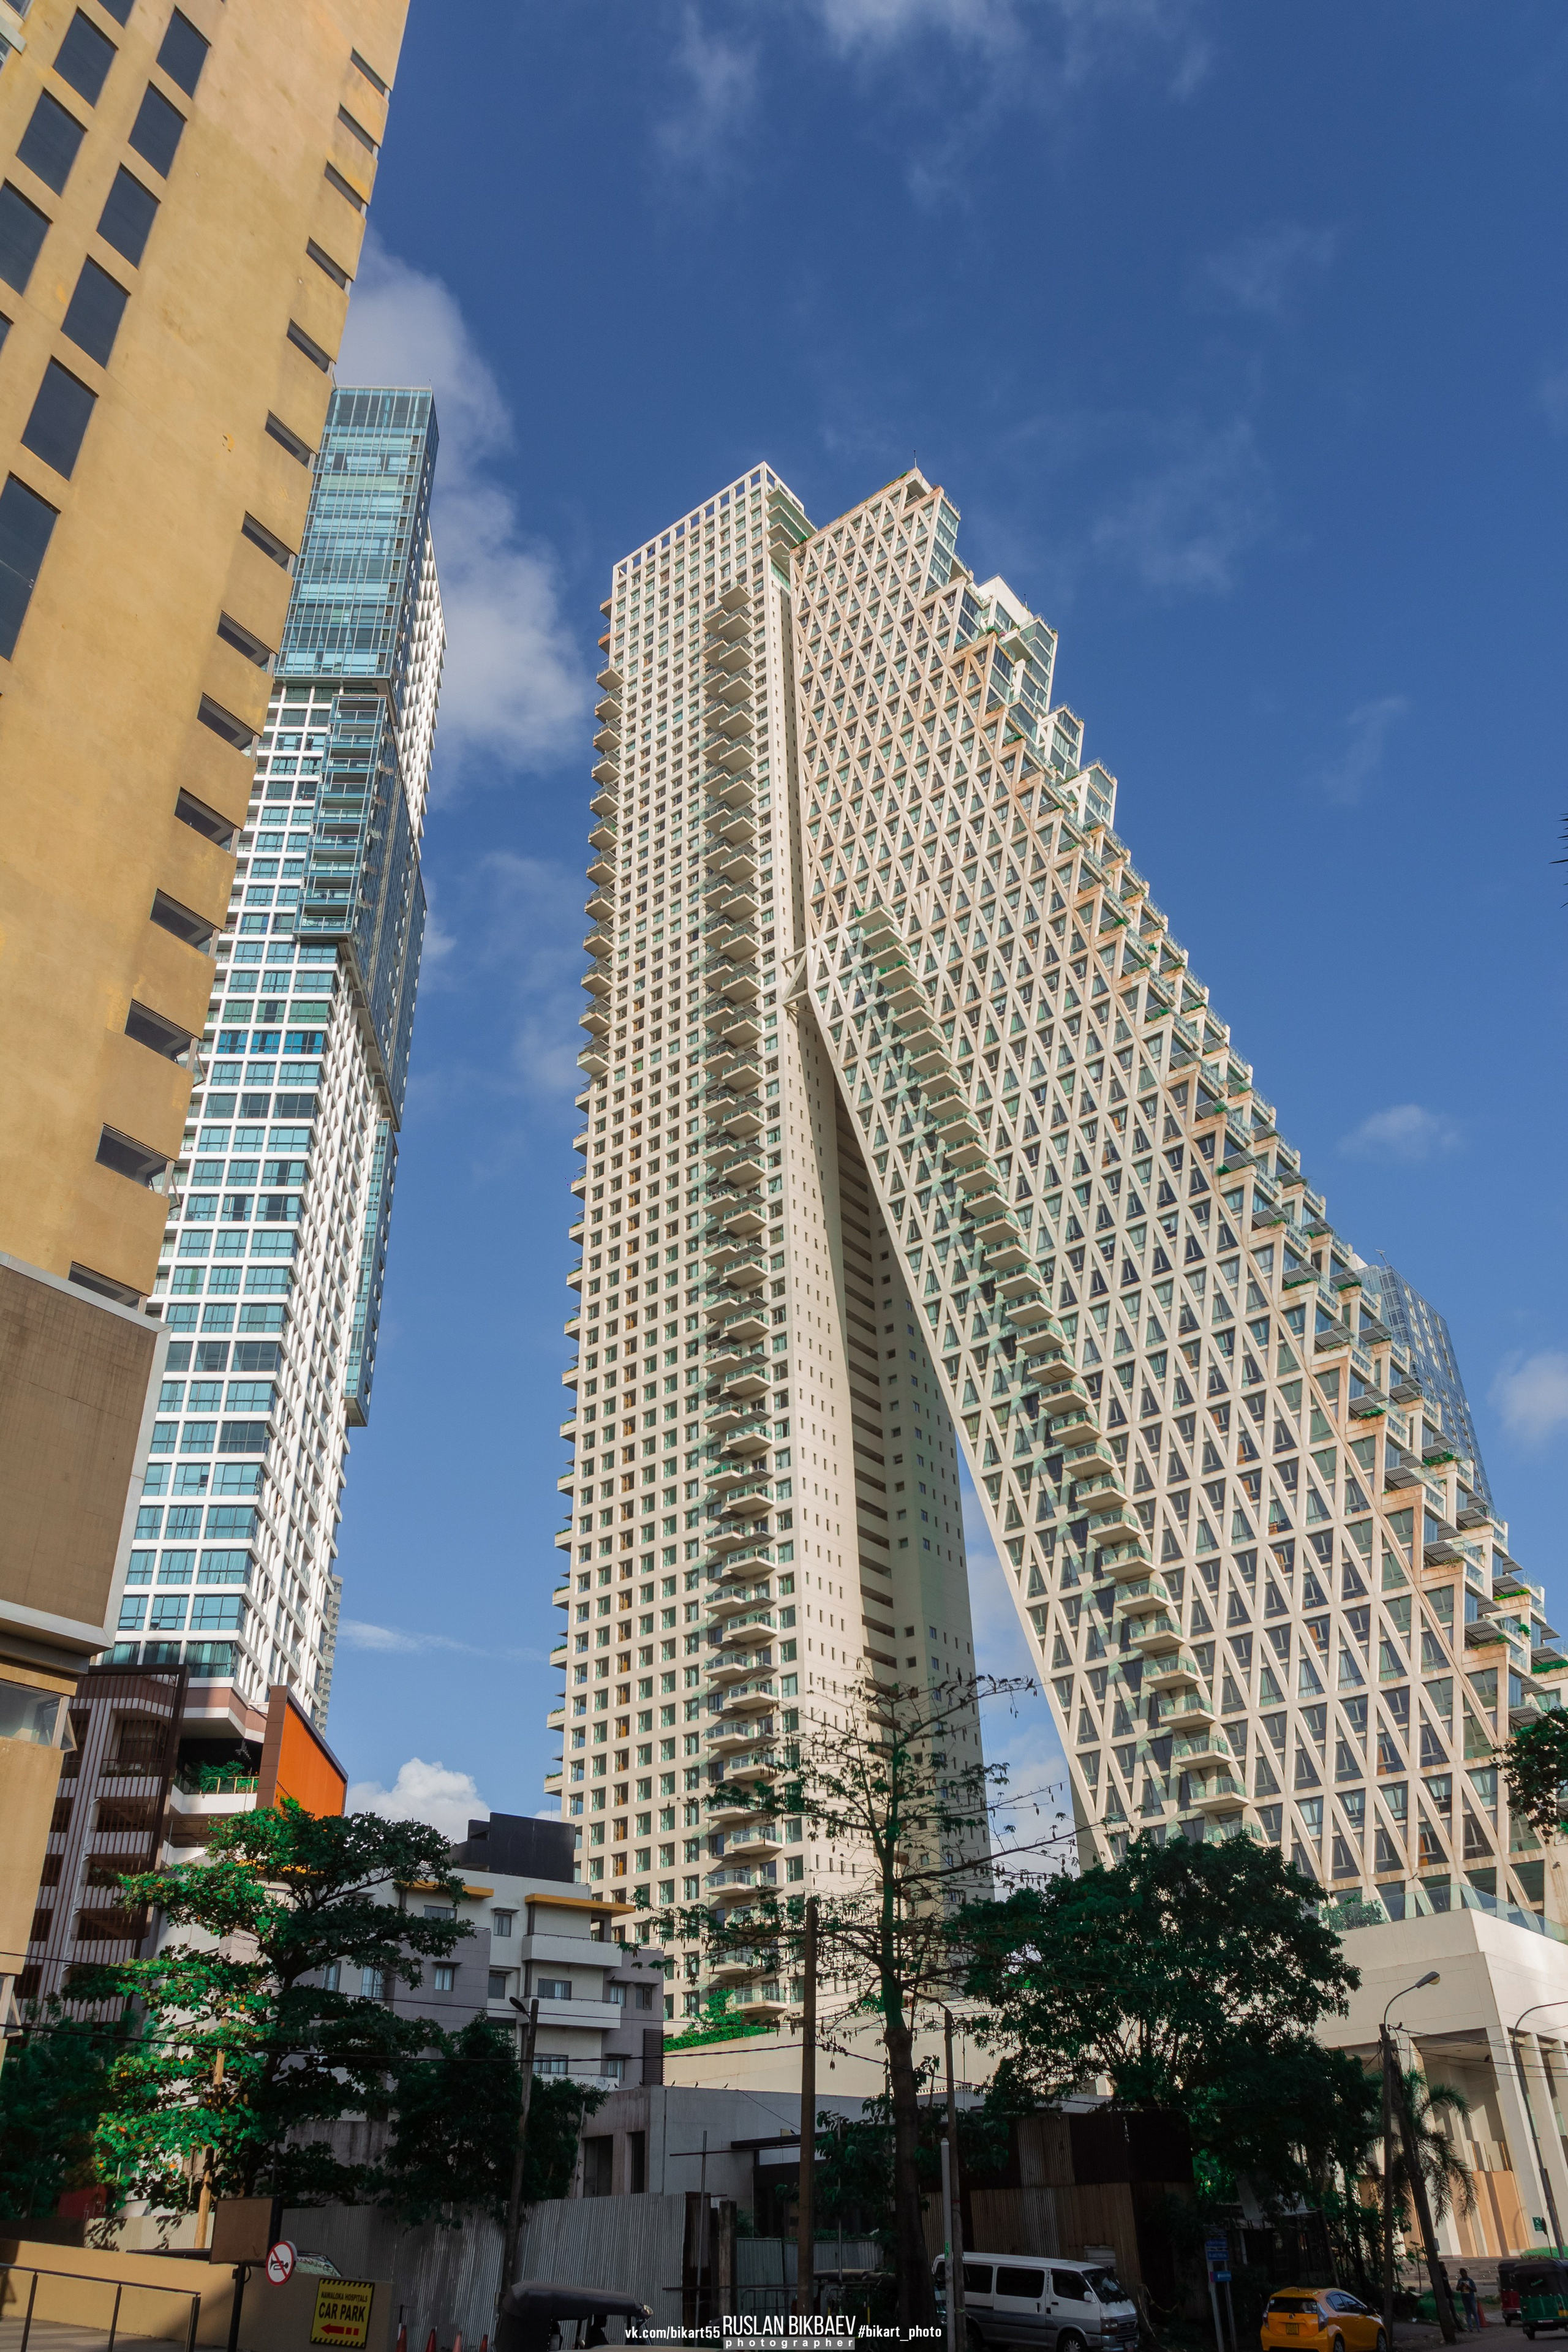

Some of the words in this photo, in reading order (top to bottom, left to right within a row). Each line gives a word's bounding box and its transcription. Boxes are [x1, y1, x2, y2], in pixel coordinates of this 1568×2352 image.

[321, 2291, 344, 2301] NAWALOKA
[345, 2293, 368, 2302] HOSPITALS
[318, 2302, 338, 2320] CAR
[339, 2304, 366, 2322] PARK
